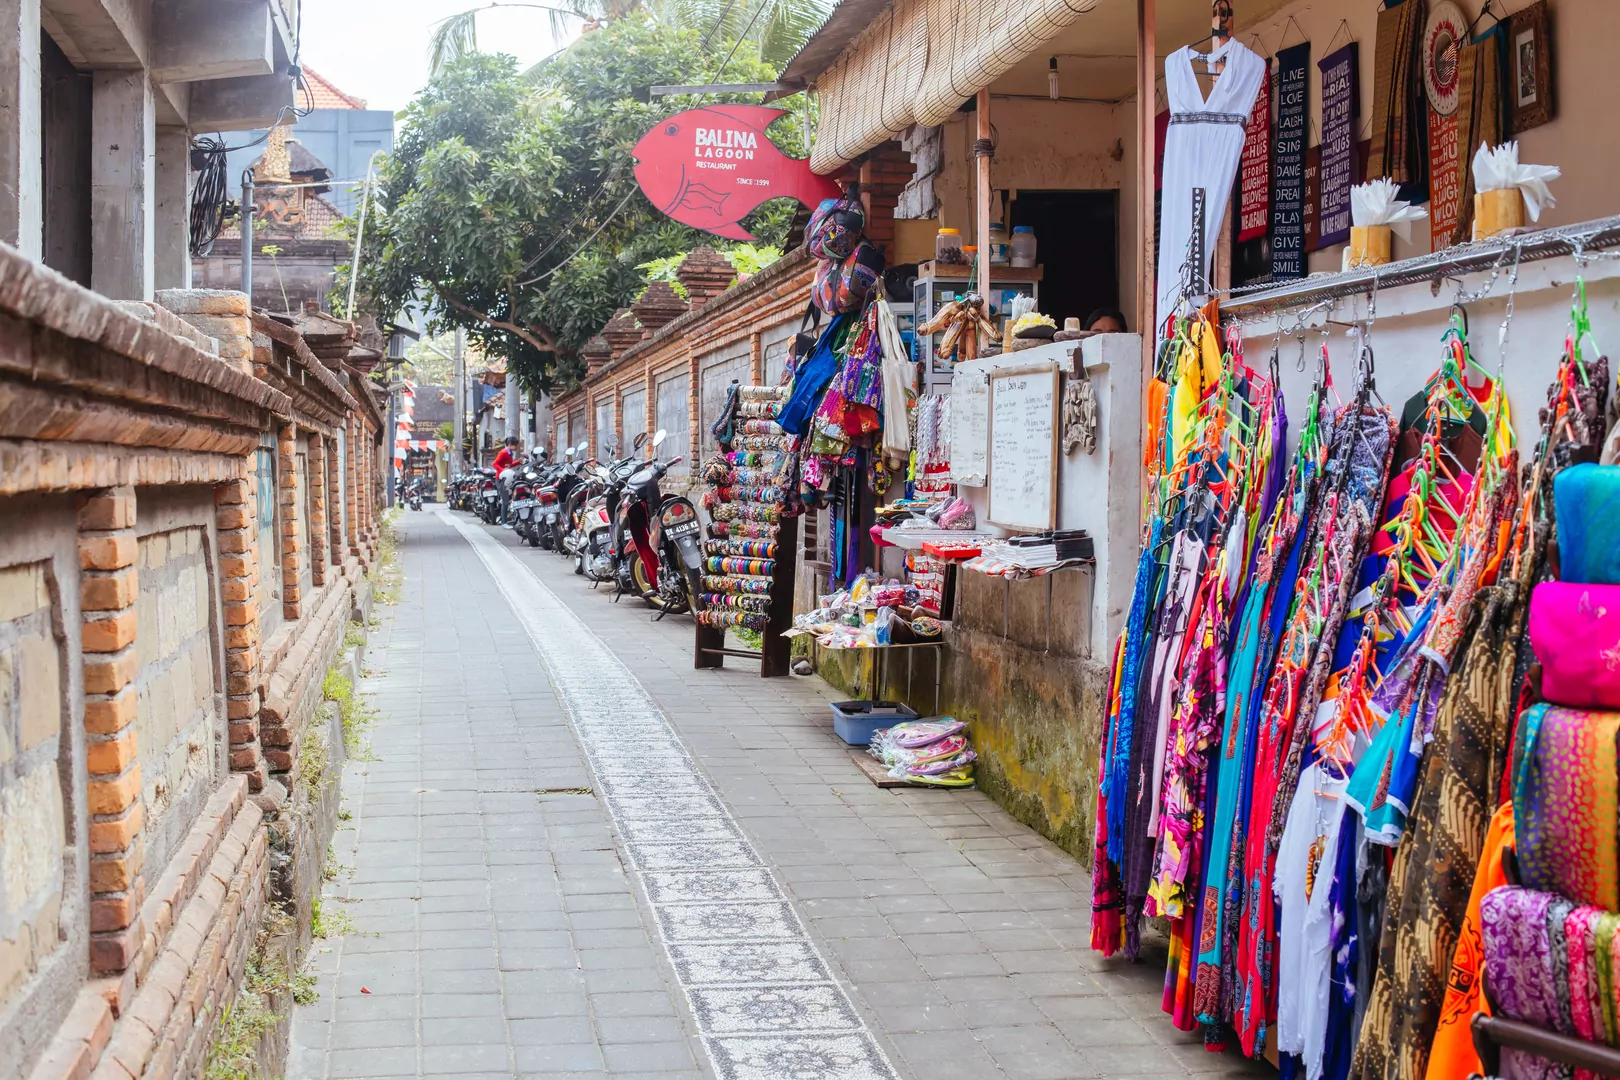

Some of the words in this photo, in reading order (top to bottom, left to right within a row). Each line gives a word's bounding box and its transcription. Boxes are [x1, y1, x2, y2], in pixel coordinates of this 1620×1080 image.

[1282, 68, 1304, 82] LIVE
[1330, 75, 1350, 97] REAL
[1281, 91, 1303, 105] LOVE
[696, 128, 758, 148] BALINA
[1332, 134, 1350, 155] HUGS
[695, 146, 754, 160] LAGOON
[1250, 140, 1268, 158] HUGS
[1278, 140, 1300, 153] SING
[1442, 142, 1458, 162] HU
[696, 160, 737, 170] RESTAURANT
[736, 178, 753, 186] SINCE
[1442, 200, 1458, 220] LOV
[1274, 212, 1300, 224] PLAY
[1274, 236, 1300, 248] GIVE
[1272, 260, 1300, 272] SMILE
